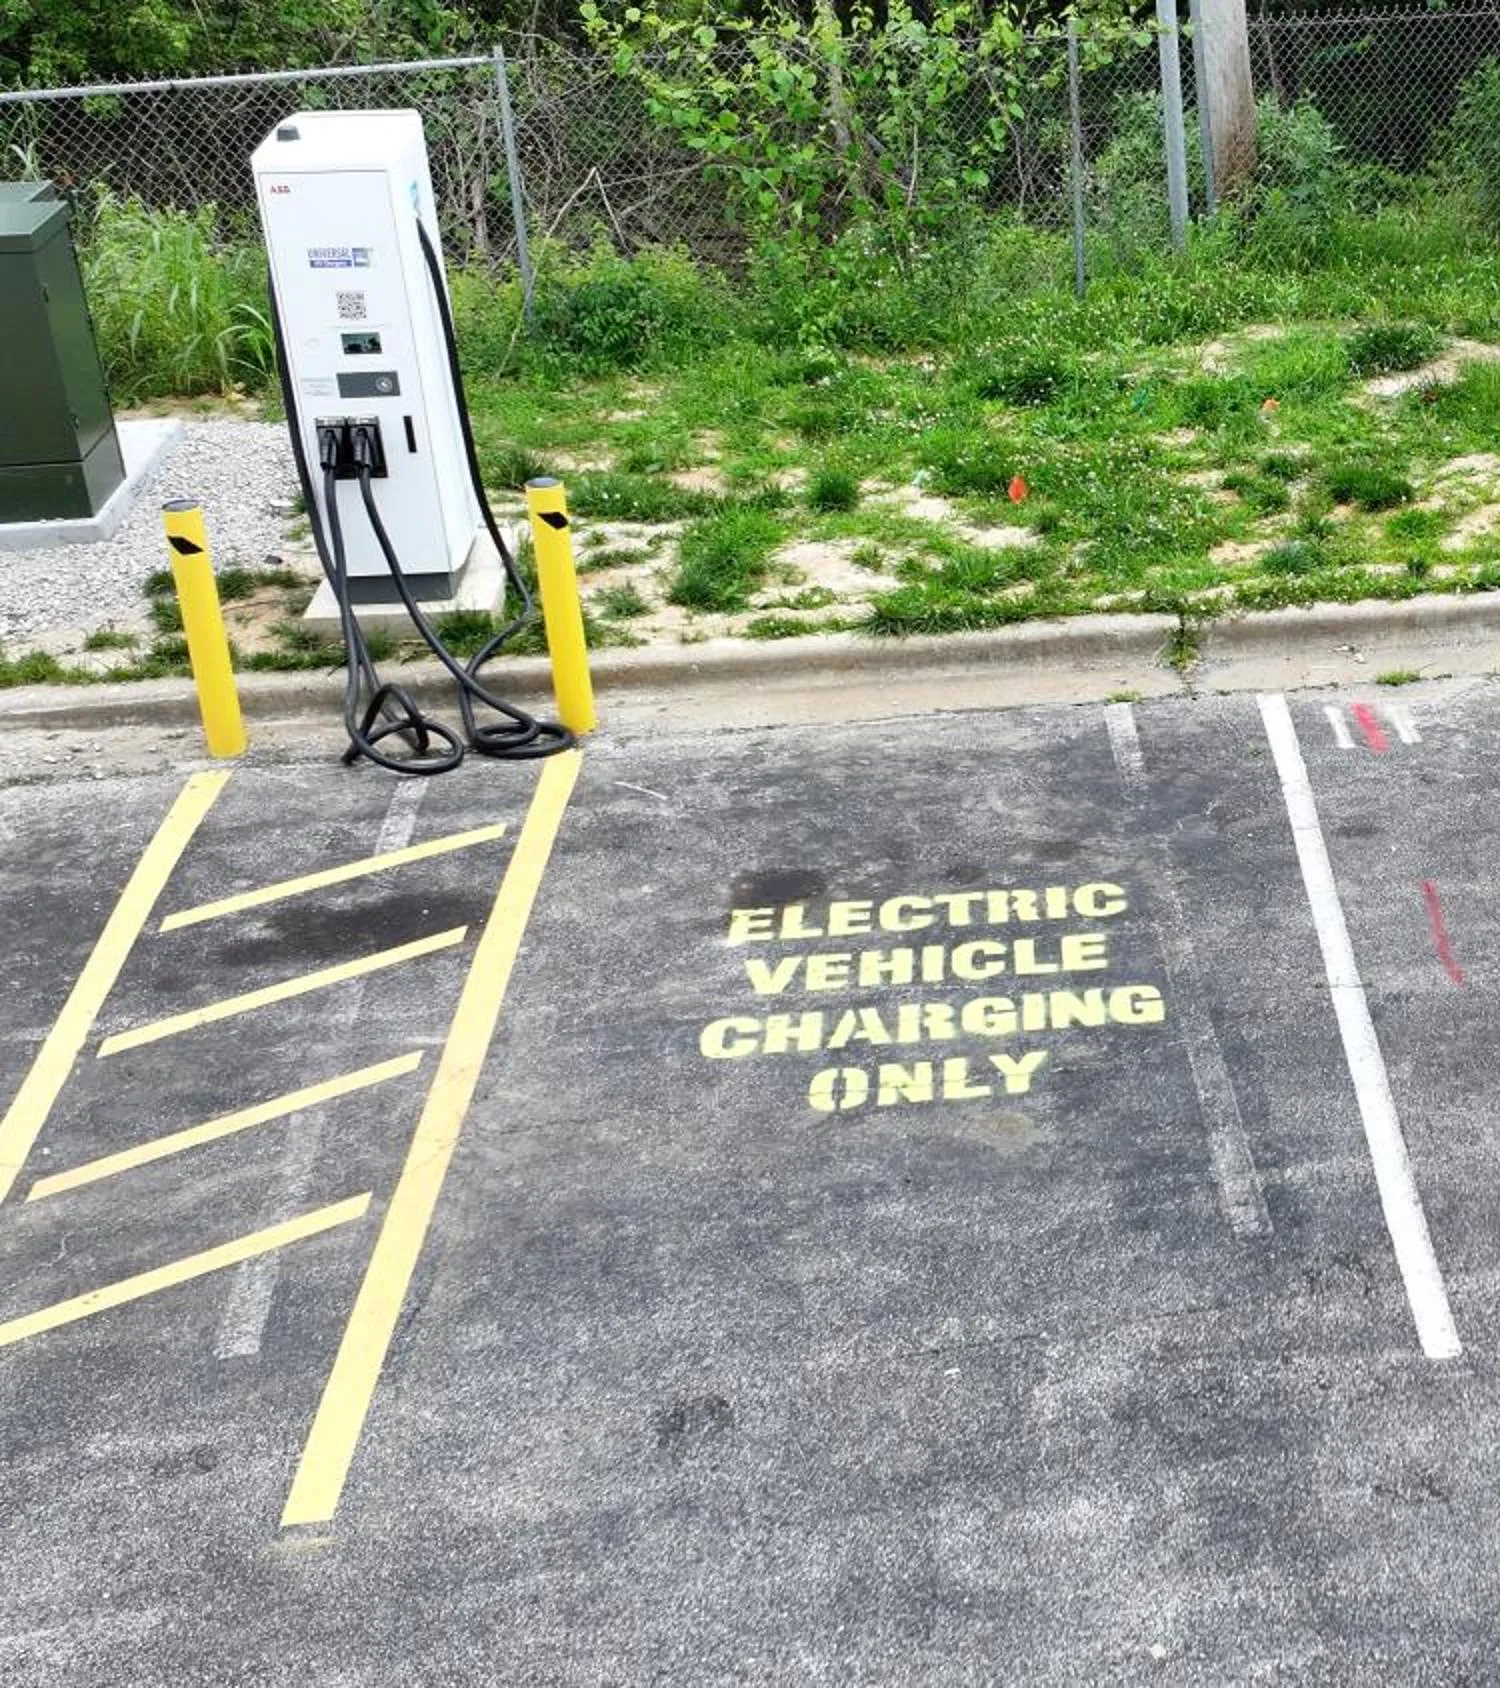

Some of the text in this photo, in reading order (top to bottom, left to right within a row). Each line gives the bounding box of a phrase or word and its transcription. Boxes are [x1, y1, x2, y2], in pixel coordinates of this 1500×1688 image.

[727, 882, 1129, 946] ELECTRIC
[744, 932, 1110, 995] VEHICLE
[699, 984, 1166, 1059] CHARGING
[807, 1050, 1050, 1112] ONLY
